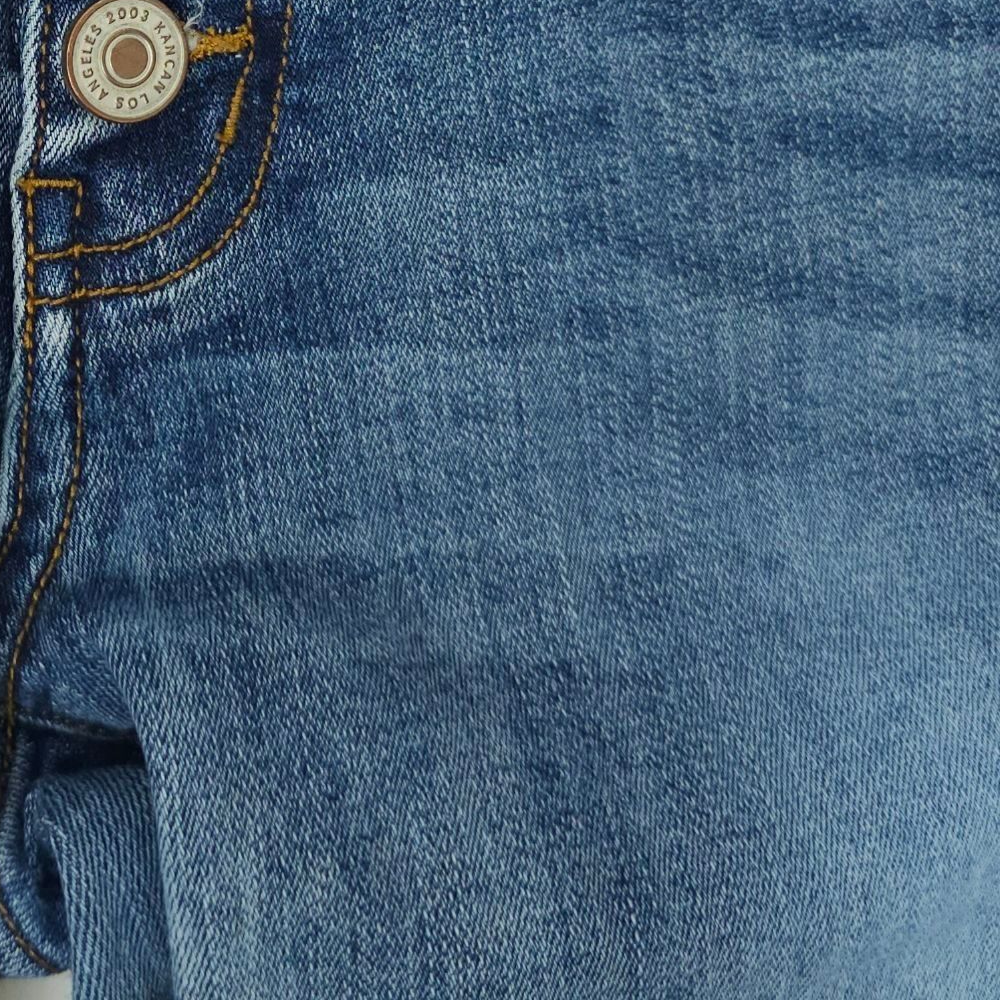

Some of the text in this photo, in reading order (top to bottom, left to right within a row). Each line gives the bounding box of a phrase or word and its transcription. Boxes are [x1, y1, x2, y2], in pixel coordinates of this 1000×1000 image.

[80, 6, 176, 110] 2003 KANCAN LOS ANGELES
